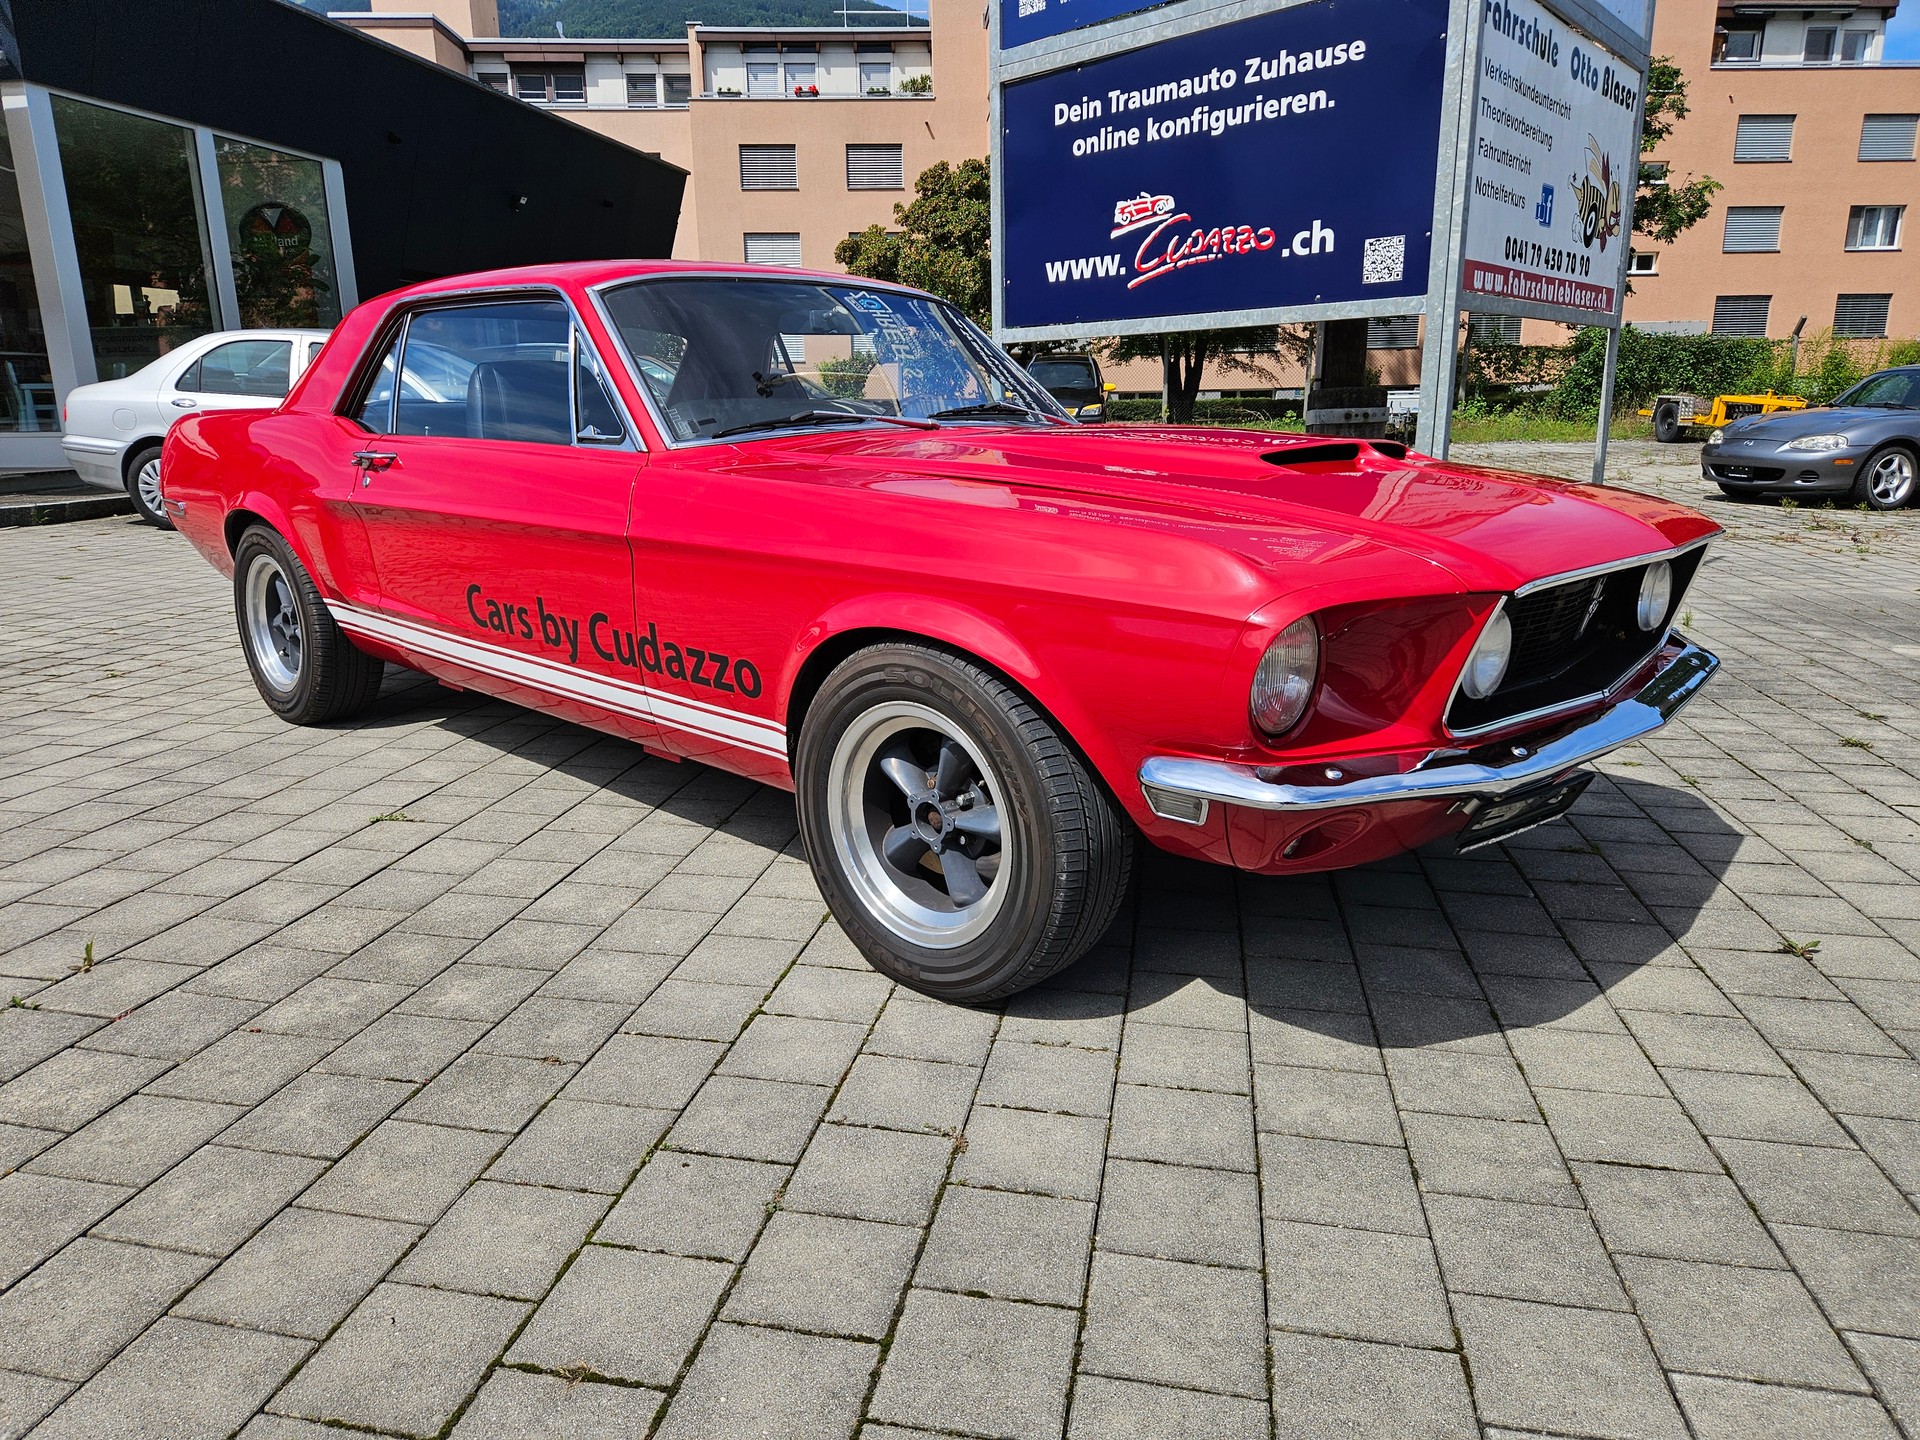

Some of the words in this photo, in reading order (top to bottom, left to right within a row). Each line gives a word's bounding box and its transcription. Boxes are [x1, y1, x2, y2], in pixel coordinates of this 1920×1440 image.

[1054, 96, 1102, 127] Dein
[1108, 67, 1237, 114] Traumauto
[1244, 39, 1367, 84] Zuhause
[1484, 0, 1559, 68] Fahrschule
[1570, 46, 1599, 91] Otto
[1601, 65, 1638, 112] Blaser
[1484, 56, 1572, 121] Verkehrskundeunterricht
[1072, 125, 1140, 157] online
[1146, 88, 1336, 142] konfigurieren.
[1481, 96, 1553, 152] Theorievorbereitung
[1478, 136, 1532, 175] Fahrunterricht
[1474, 175, 1526, 210] Nothelferkurs
[1504, 235, 1529, 265] 0041
[1530, 243, 1542, 268] 79
[1544, 247, 1563, 272] 430
[1565, 251, 1577, 275] 70
[1579, 254, 1590, 277] 90
[1473, 269, 1608, 309] www.fahrschuleblaser.ch
[466, 583, 534, 640] Cars
[536, 596, 578, 664] by
[588, 612, 762, 699] Cudazzo
[883, 666, 996, 743] SOLUS
